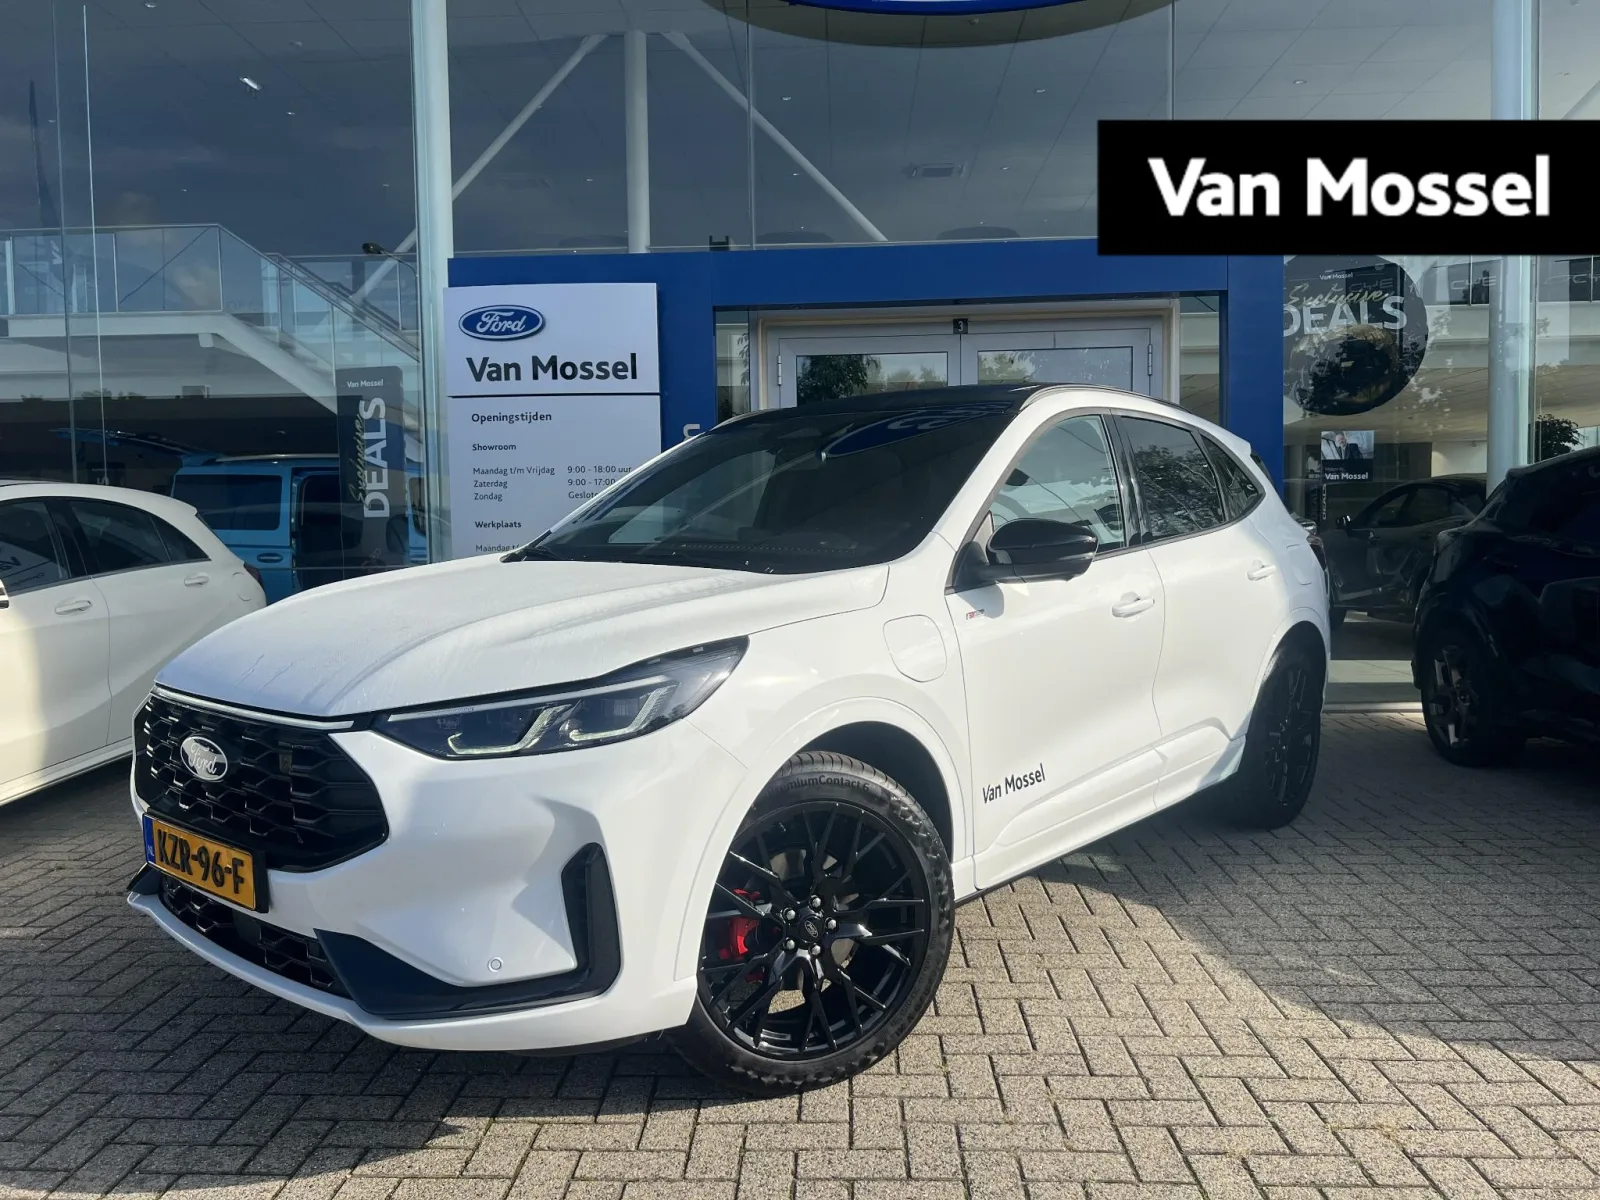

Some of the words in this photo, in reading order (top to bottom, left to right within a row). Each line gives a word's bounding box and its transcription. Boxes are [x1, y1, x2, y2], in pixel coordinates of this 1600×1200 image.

[475, 310, 527, 333] Ford
[465, 357, 521, 382] Van
[531, 352, 638, 381] Mossel
[346, 380, 359, 388] Van
[360, 378, 384, 387] Mossel
[471, 411, 552, 424] Openingstijden
[472, 443, 516, 451] Showroom
[358, 397, 390, 518] DEALS
[473, 467, 507, 476] Maandag
[510, 466, 525, 475] t/m
[526, 466, 555, 476] Vrijdag
[1341, 472, 1368, 480] Mossel
[474, 480, 508, 489] Zaterdag
[595, 478, 615, 486] 17:00
[474, 492, 503, 502] Zondag
[475, 521, 522, 530] Werkplaats
[476, 544, 509, 552] Maandag
[188, 742, 218, 774] Ford
[982, 784, 1002, 804] Van
[1004, 762, 1046, 795] Mossel
[157, 828, 245, 895] KZR-96-F
